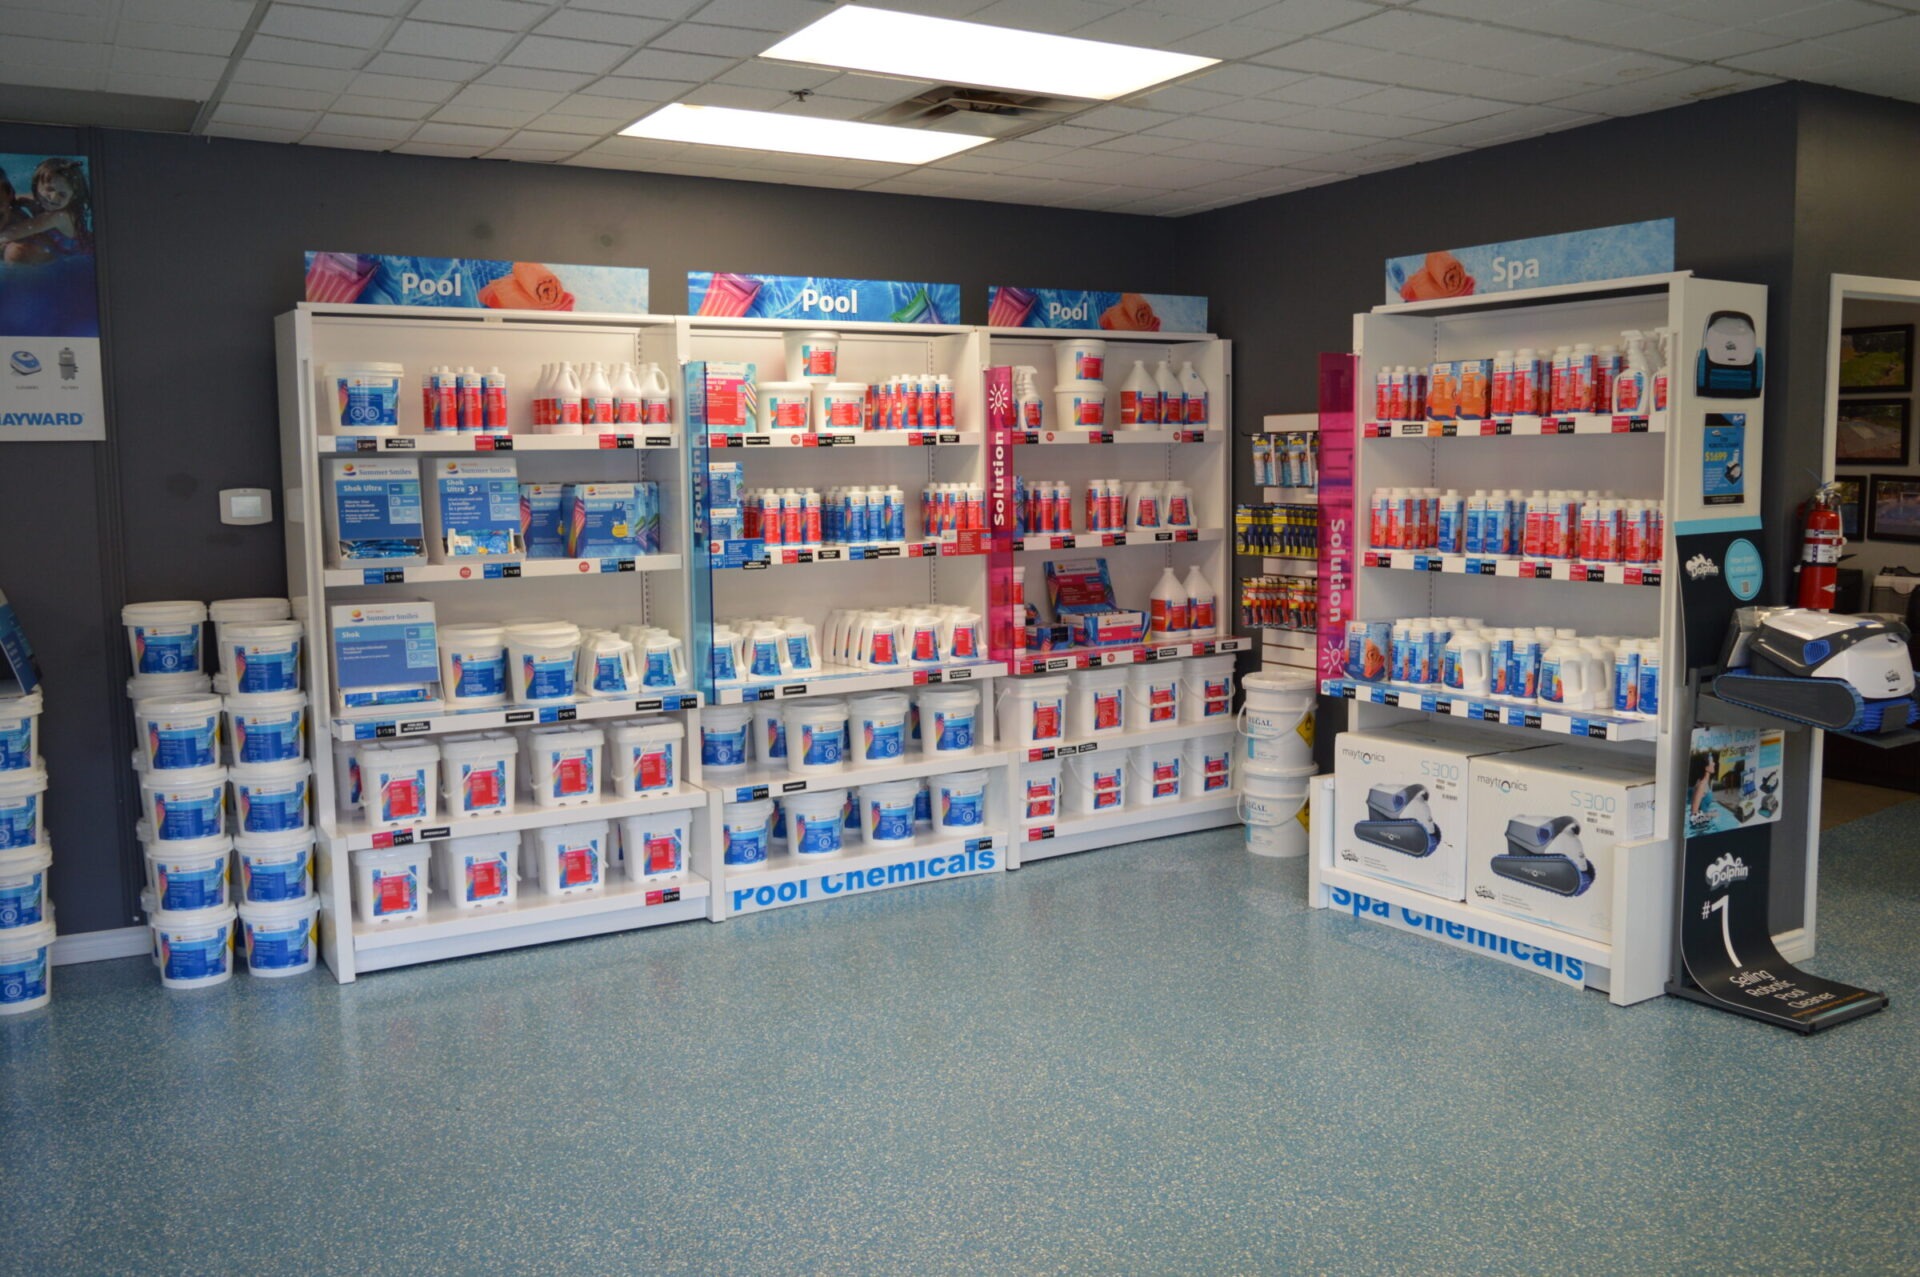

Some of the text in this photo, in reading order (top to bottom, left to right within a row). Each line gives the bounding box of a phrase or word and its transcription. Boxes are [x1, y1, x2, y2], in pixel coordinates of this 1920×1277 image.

[1492, 256, 1539, 288] Spa
[402, 273, 461, 296] Pool
[802, 289, 857, 313] Pool
[1049, 303, 1088, 320] Pool
[0, 413, 83, 426] AYWARD
[343, 484, 383, 492] Shok Ultra
[691, 436, 703, 534] Routin
[993, 431, 1005, 526] Solution
[1329, 518, 1346, 623] Solution
[1691, 563, 1719, 578] Dolphin
[342, 631, 360, 639] Shok
[1342, 748, 1385, 764] maytronics
[1477, 774, 1528, 793] maytronics
[1711, 865, 1749, 887] Dolphin
[1729, 969, 1776, 988] Selling
[1745, 979, 1796, 998] Robotic
[1773, 988, 1810, 1001] Pool
[1787, 991, 1836, 1009] Cleaner
